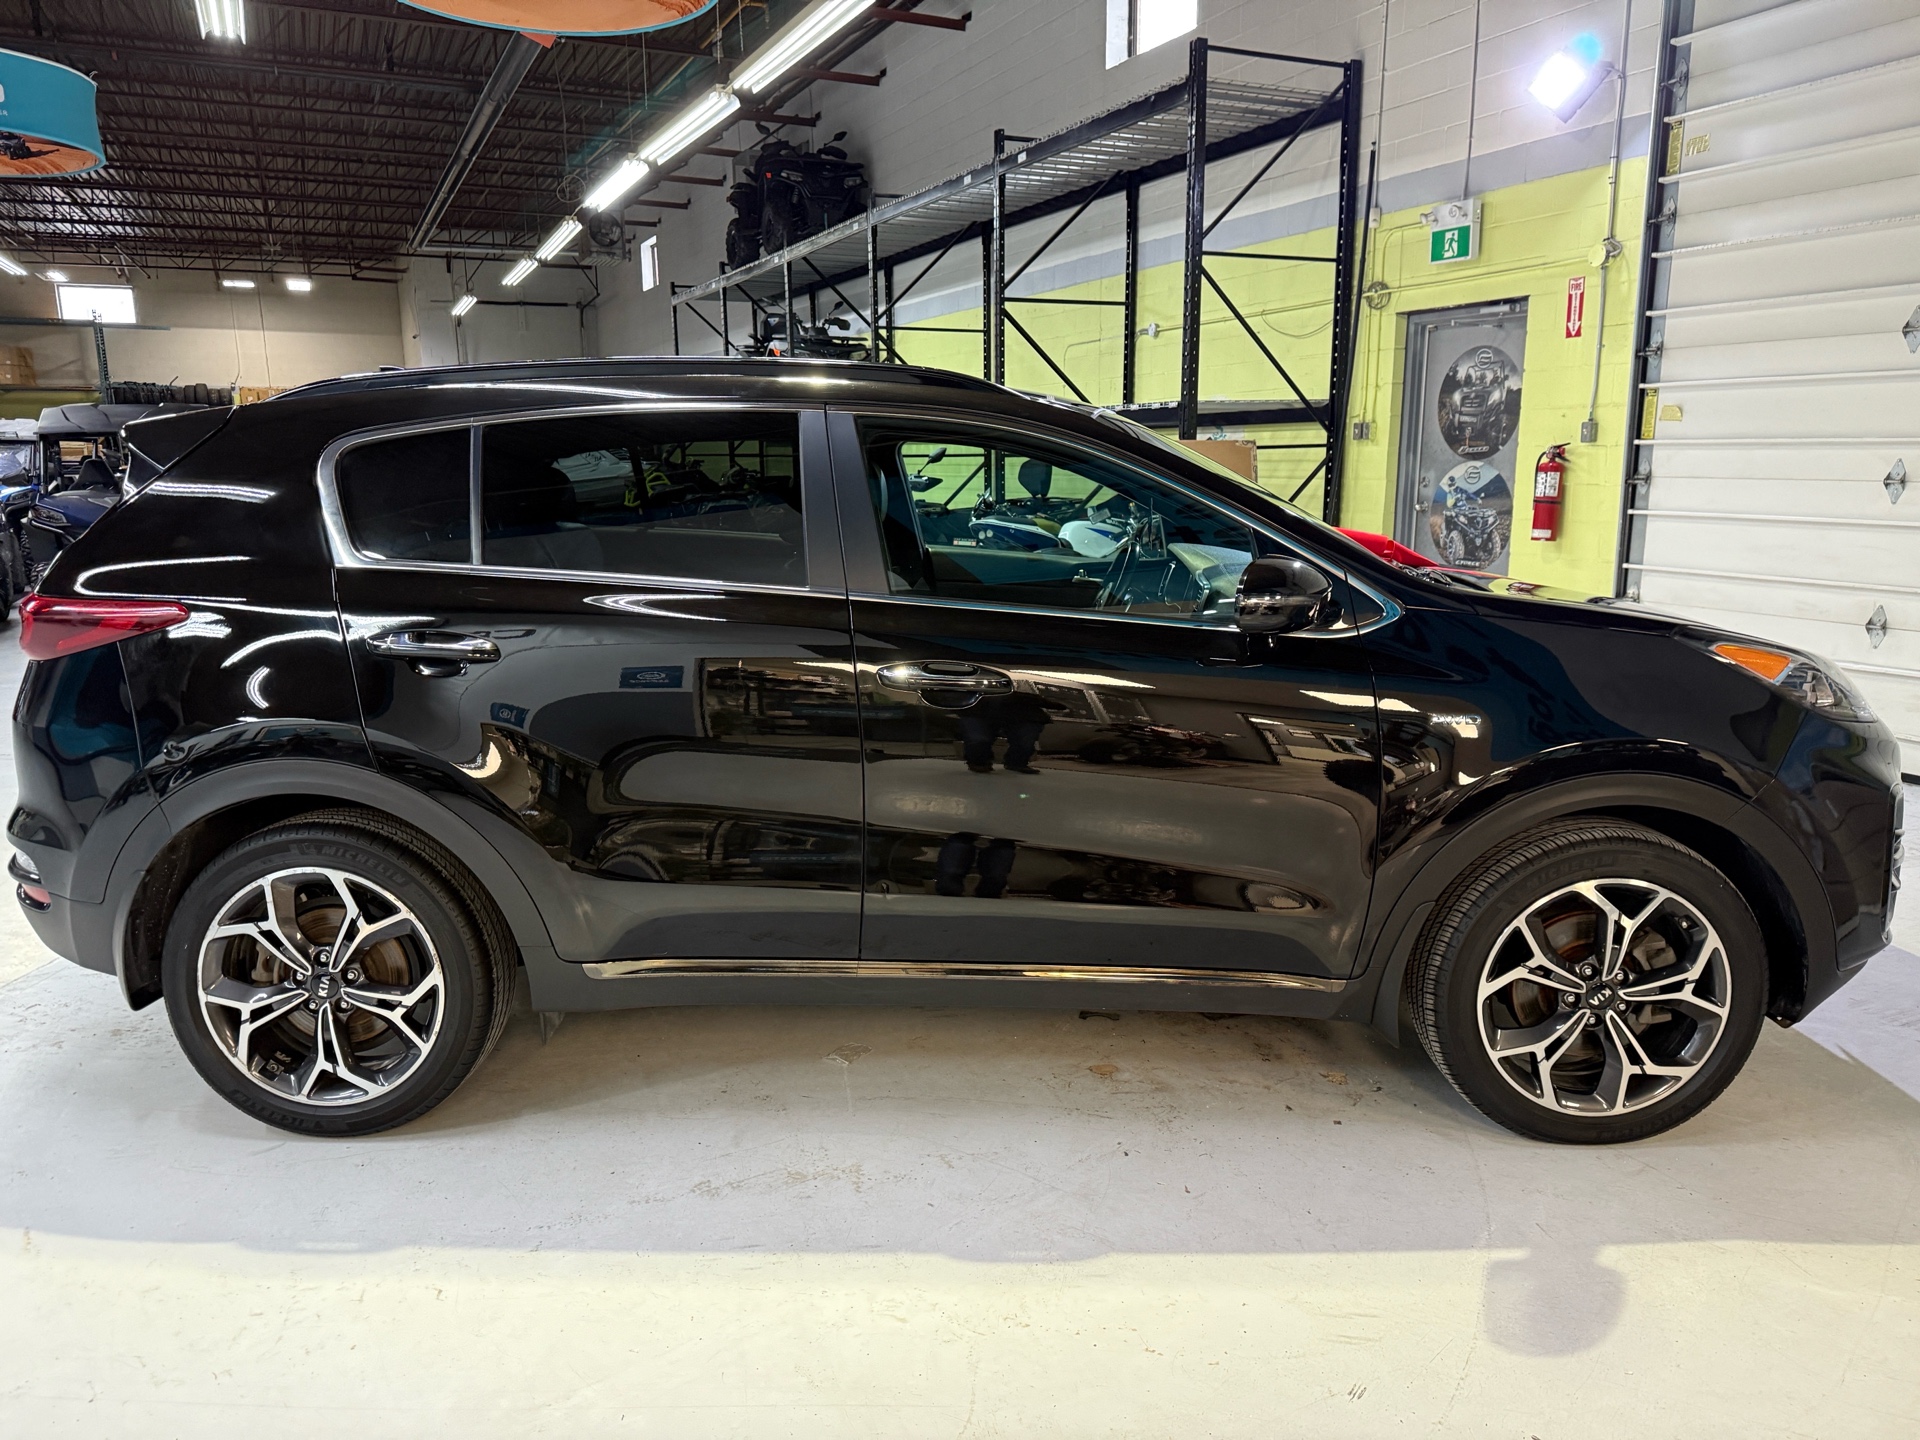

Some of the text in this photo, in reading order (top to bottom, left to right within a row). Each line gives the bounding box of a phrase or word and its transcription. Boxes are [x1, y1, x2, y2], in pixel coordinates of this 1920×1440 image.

[1571, 282, 1582, 292] FIRE
[1430, 714, 1482, 725] AWD
[321, 845, 406, 884] MICHELIN
[317, 975, 331, 998] KIA
[1589, 987, 1613, 1006] KIA
